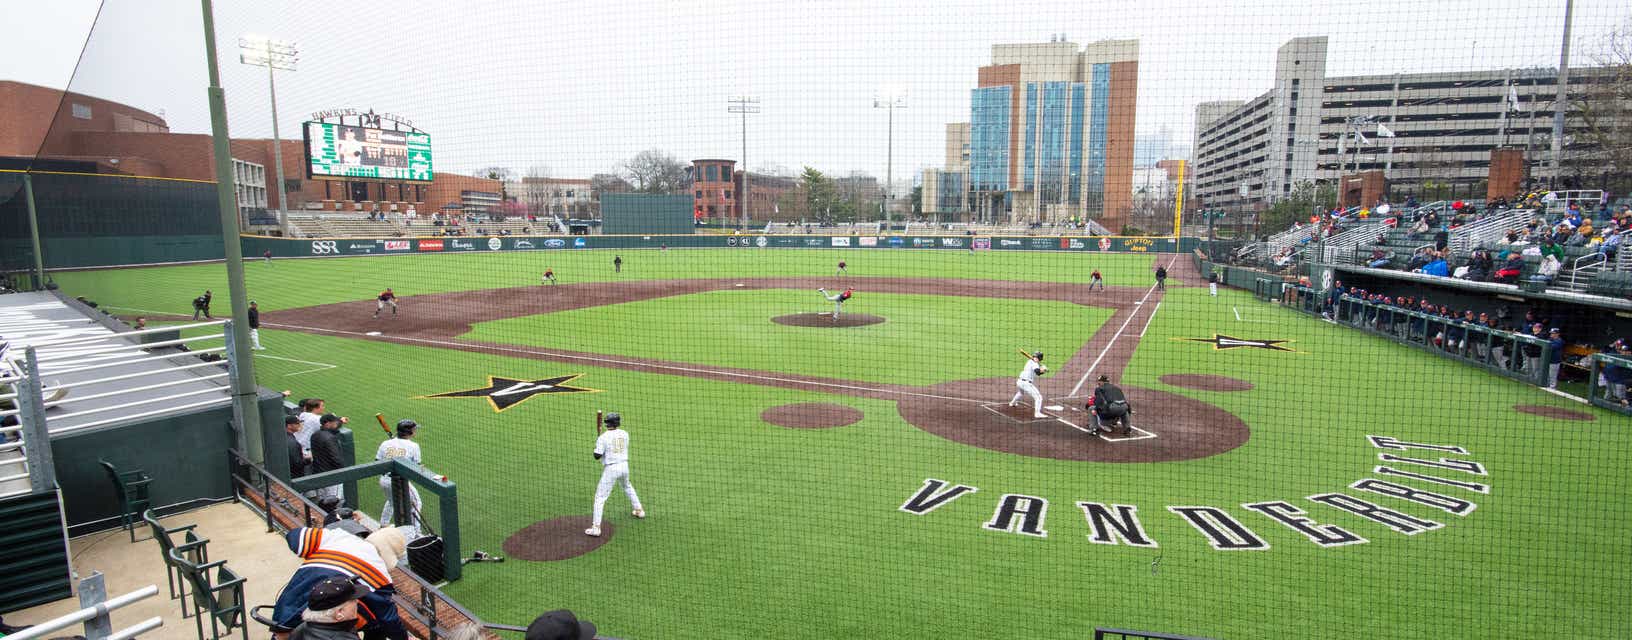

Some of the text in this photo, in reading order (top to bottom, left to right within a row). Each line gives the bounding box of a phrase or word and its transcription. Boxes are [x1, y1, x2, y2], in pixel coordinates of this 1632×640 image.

[311, 107, 358, 121] HAWKINS
[311, 240, 340, 254] SSR
[898, 434, 1490, 551] VANDERBILT
